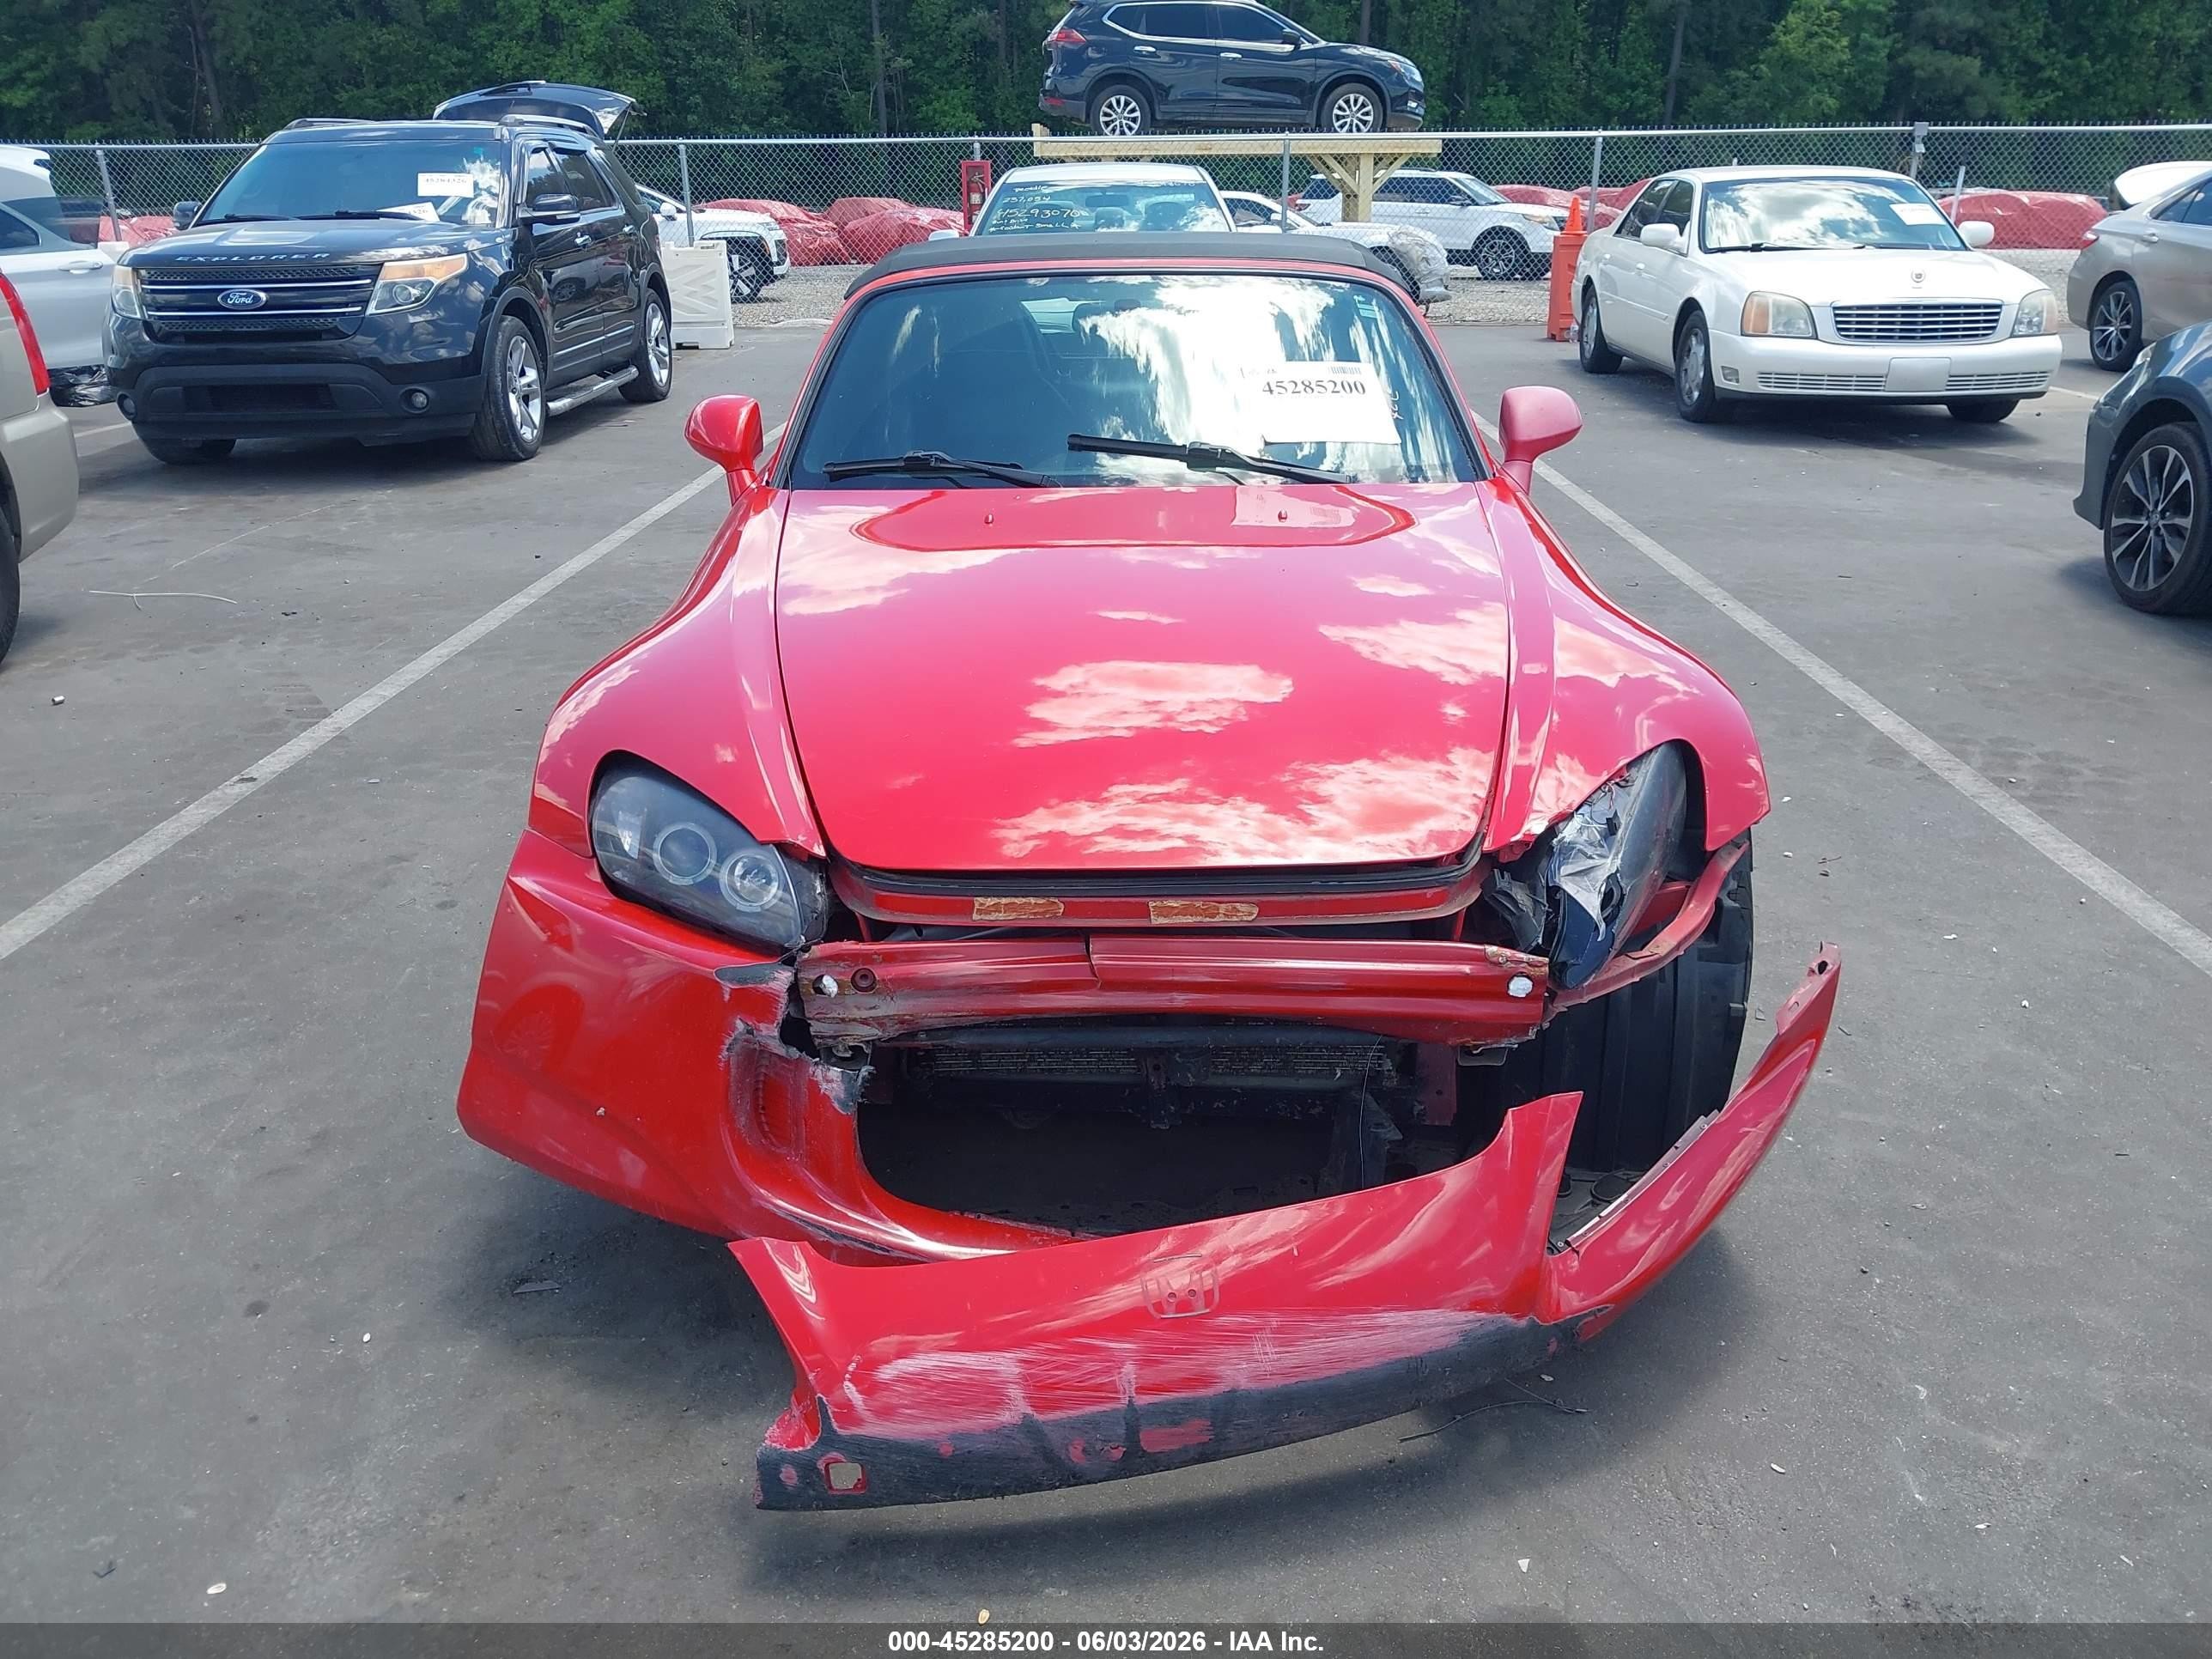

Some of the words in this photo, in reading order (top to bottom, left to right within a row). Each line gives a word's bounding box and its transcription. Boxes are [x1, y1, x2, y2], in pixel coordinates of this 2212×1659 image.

[997, 209, 1079, 218] 45293070
[175, 253, 331, 262] EXPLORER
[227, 291, 254, 305] Ford
[1262, 379, 1366, 396] 45285200
